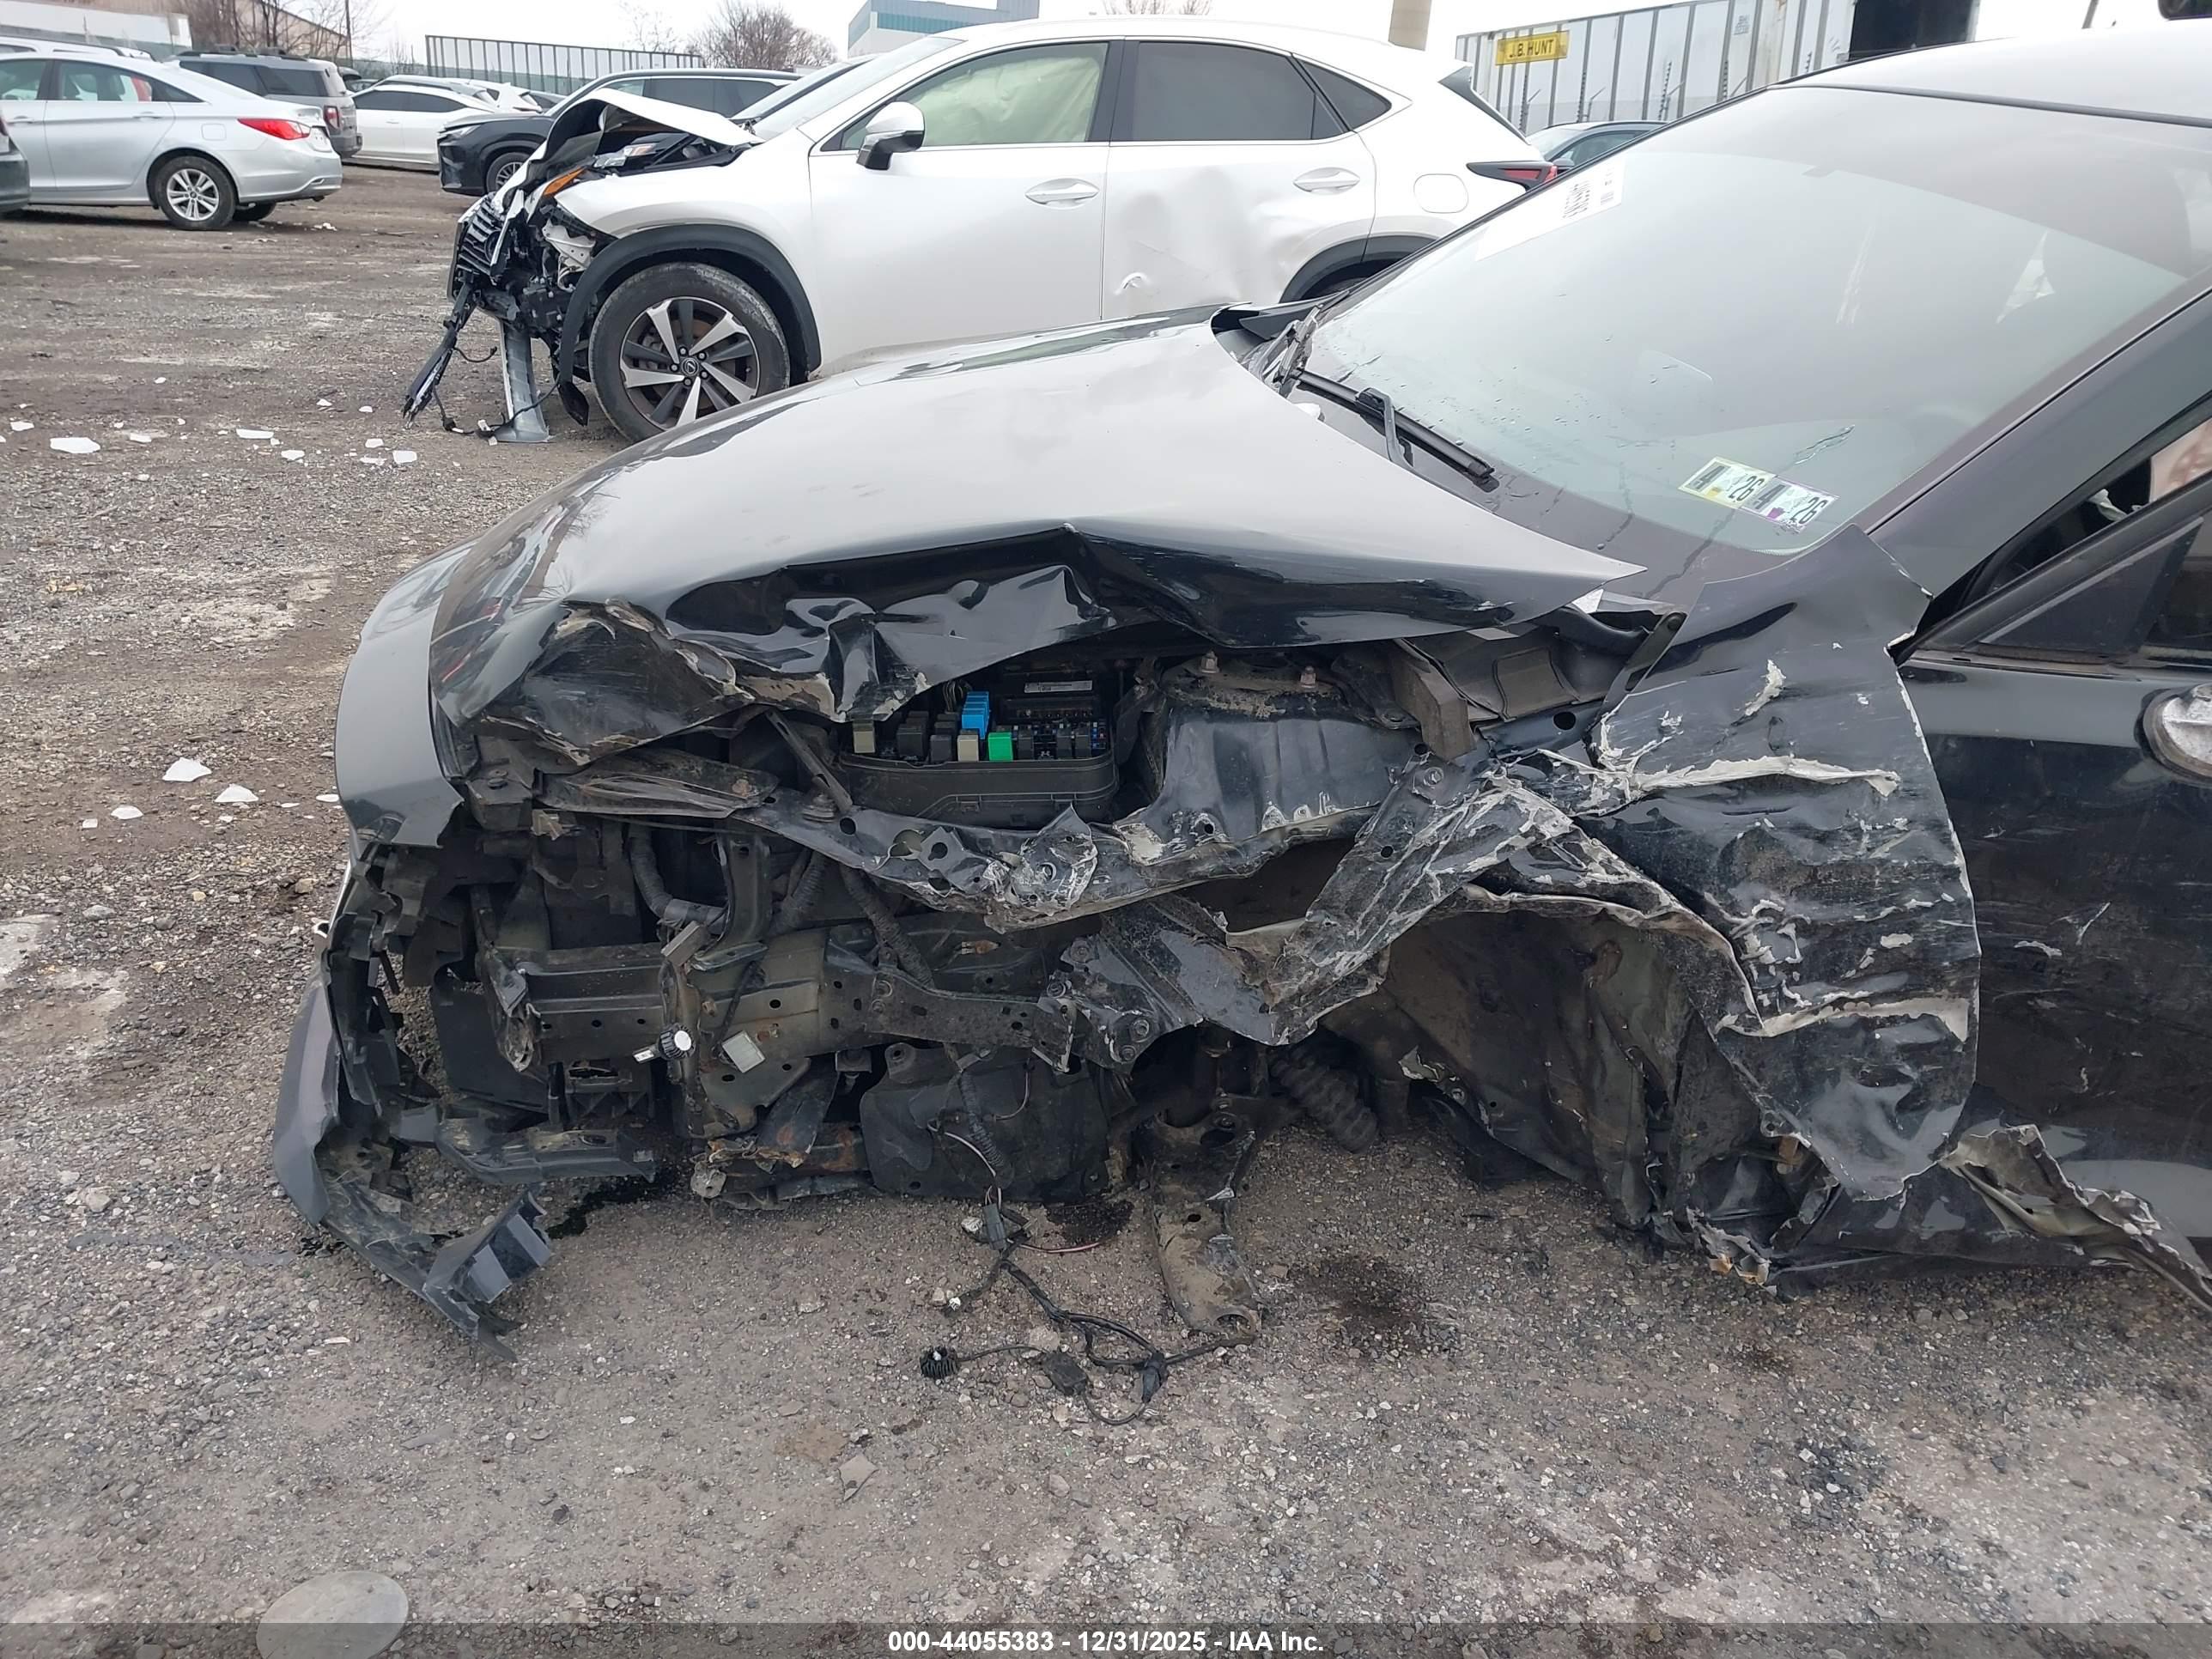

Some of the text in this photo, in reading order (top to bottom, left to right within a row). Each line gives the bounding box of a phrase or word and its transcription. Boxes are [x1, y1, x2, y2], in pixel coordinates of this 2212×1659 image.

[1528, 39, 1553, 56] HUNT
[1728, 476, 1765, 501] 26
[1790, 496, 1828, 525] 26
